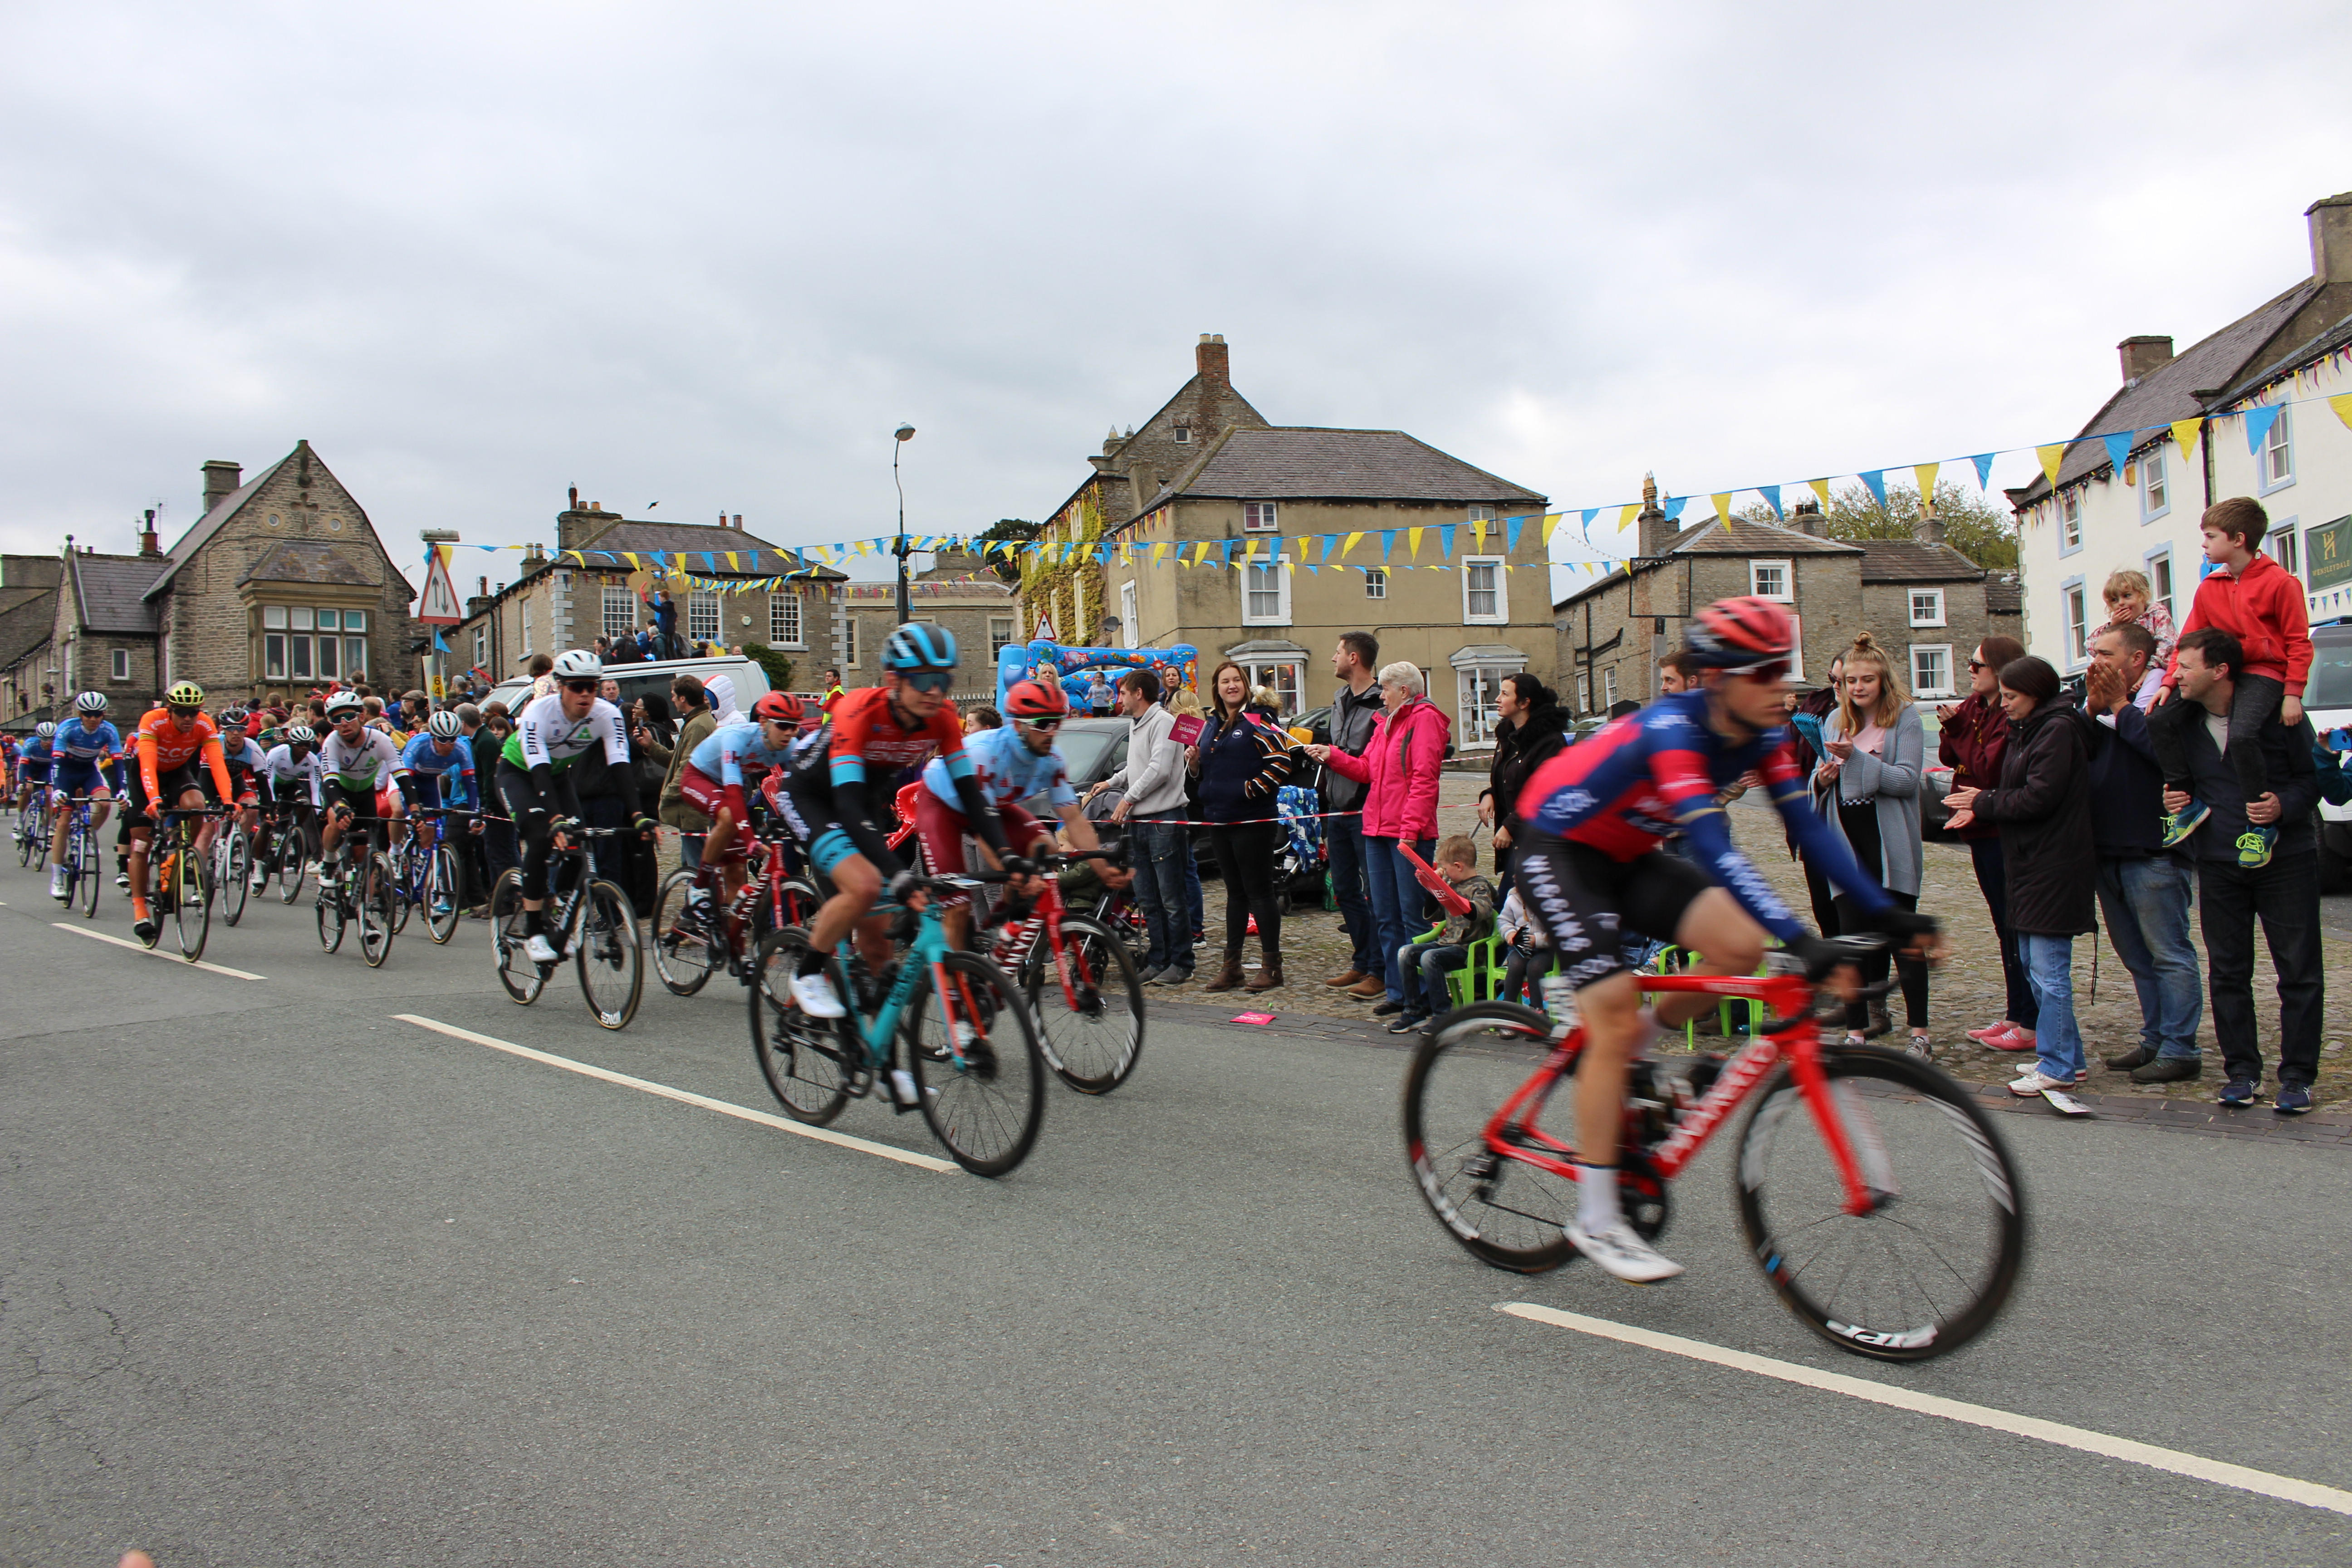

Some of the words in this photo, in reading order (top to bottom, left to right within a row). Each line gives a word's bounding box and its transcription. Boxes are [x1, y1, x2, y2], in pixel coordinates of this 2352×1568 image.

[2312, 560, 2350, 576] WENSLEYDALE
[1178, 724, 1197, 735] Yorkshire
[157, 746, 195, 758] CCC
[143, 775, 154, 793] CCC
[738, 872, 772, 920] CANYON
[999, 917, 1044, 976] ANYON
